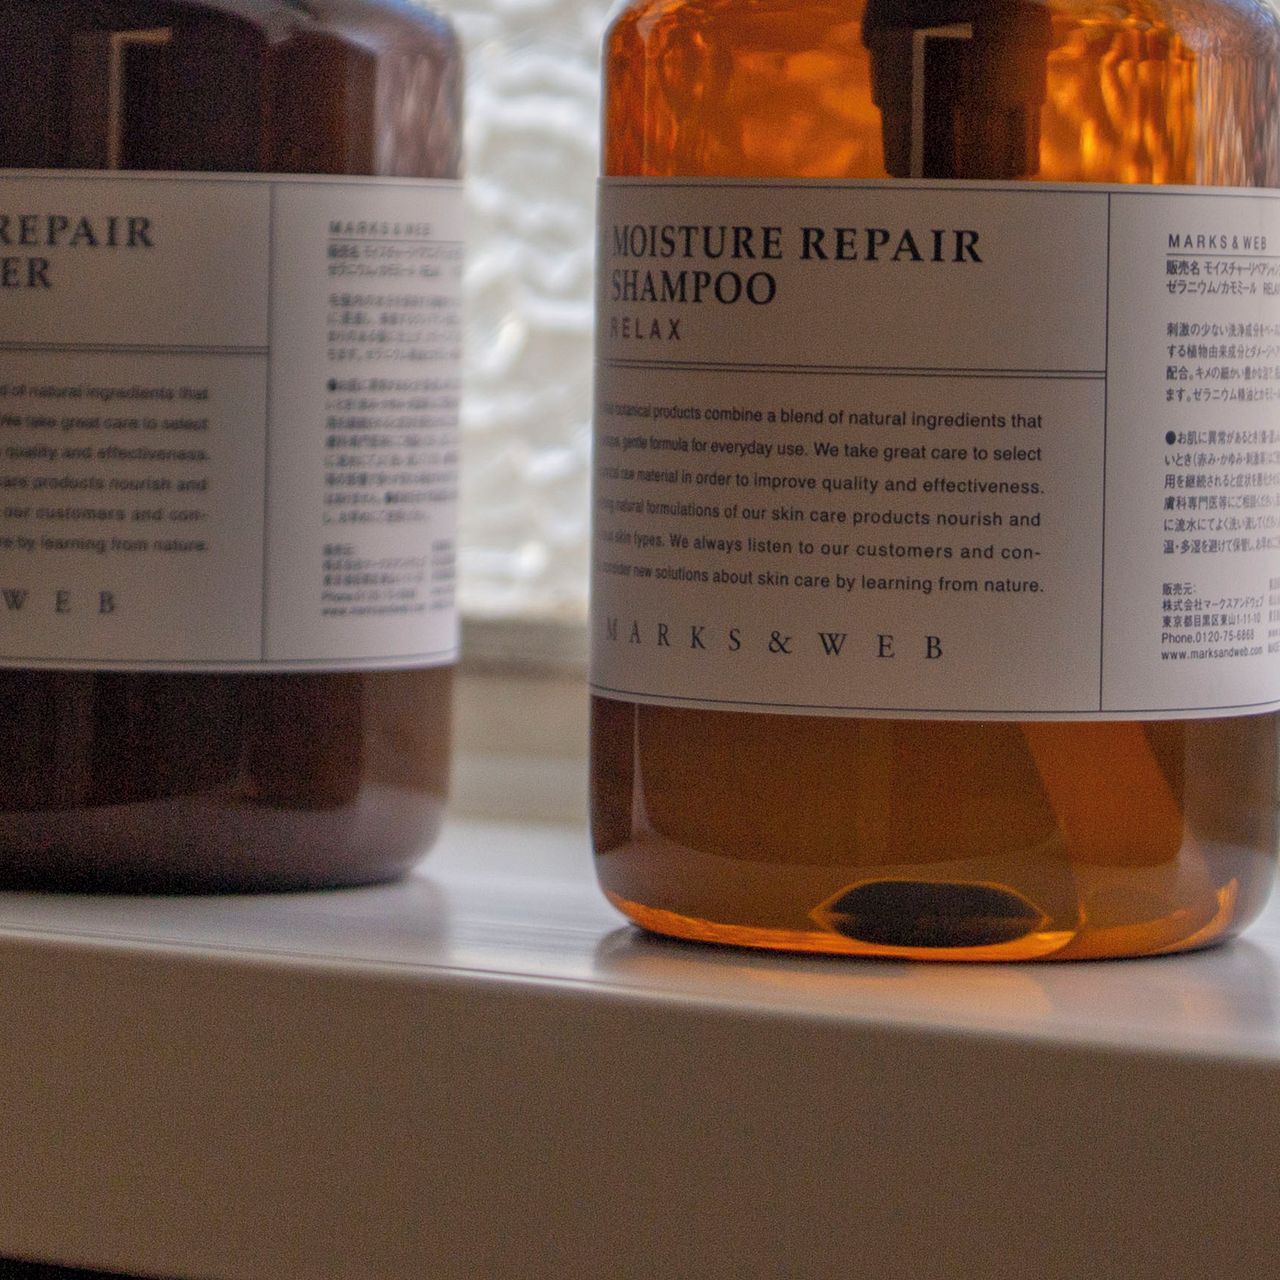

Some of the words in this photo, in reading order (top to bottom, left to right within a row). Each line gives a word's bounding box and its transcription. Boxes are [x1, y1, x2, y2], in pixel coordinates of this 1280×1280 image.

[612, 224, 783, 260] MOISTURE
[799, 226, 984, 263] REPAIR
[1167, 233, 1228, 250] MARKS
[1242, 235, 1267, 251] WEB
[1166, 259, 1201, 276] 販売名
[611, 268, 777, 305] SHAMPOO
[610, 317, 681, 340] RELAX
[653, 406, 701, 421] products
[704, 407, 762, 422] combine
[767, 412, 776, 423] a
[780, 409, 824, 424] blend
[828, 409, 844, 424] of
[848, 411, 906, 426] natural
[911, 411, 1006, 430] ingredients
[1011, 414, 1043, 428] that
[691, 436, 707, 452] for
[711, 441, 772, 457] everyday
[777, 444, 808, 456] use.
[814, 442, 840, 457] We
[844, 443, 879, 458] take
[883, 445, 927, 462] great
[931, 448, 967, 460] care
[973, 446, 988, 461] to
[993, 445, 1043, 461] select
[681, 470, 692, 483] in
[696, 472, 731, 486] order
[736, 473, 749, 487] to
[754, 473, 817, 491] improve
[821, 476, 879, 495] quality
[884, 477, 917, 492] and
[923, 477, 1045, 494] effectiveness.
[646, 499, 719, 518] formulations
[724, 504, 738, 519] of
[742, 508, 766, 520] our
[771, 506, 804, 521] skin
[809, 510, 846, 523] care
[852, 509, 930, 527] products
[936, 511, 1003, 526] nourish
[1009, 512, 1041, 527] and
[670, 533, 689, 548] We
[693, 535, 742, 553] always
[747, 537, 793, 554] listen
[798, 540, 814, 555] to
[821, 543, 849, 556] our
[856, 543, 953, 558] customers
[960, 544, 994, 559] and
[1000, 547, 1041, 560] con-
[655, 565, 709, 582] solutions
[712, 570, 753, 585] about
[757, 570, 790, 586] skin
[794, 575, 830, 587] care
[836, 574, 856, 592] by
[861, 575, 933, 595] learning
[939, 576, 978, 591] from
[984, 578, 1045, 592] nature.
[1, 587, 116, 615] WEB
[606, 616, 742, 652] MARKS
[767, 629, 793, 655] &
[818, 631, 944, 660] WEB
